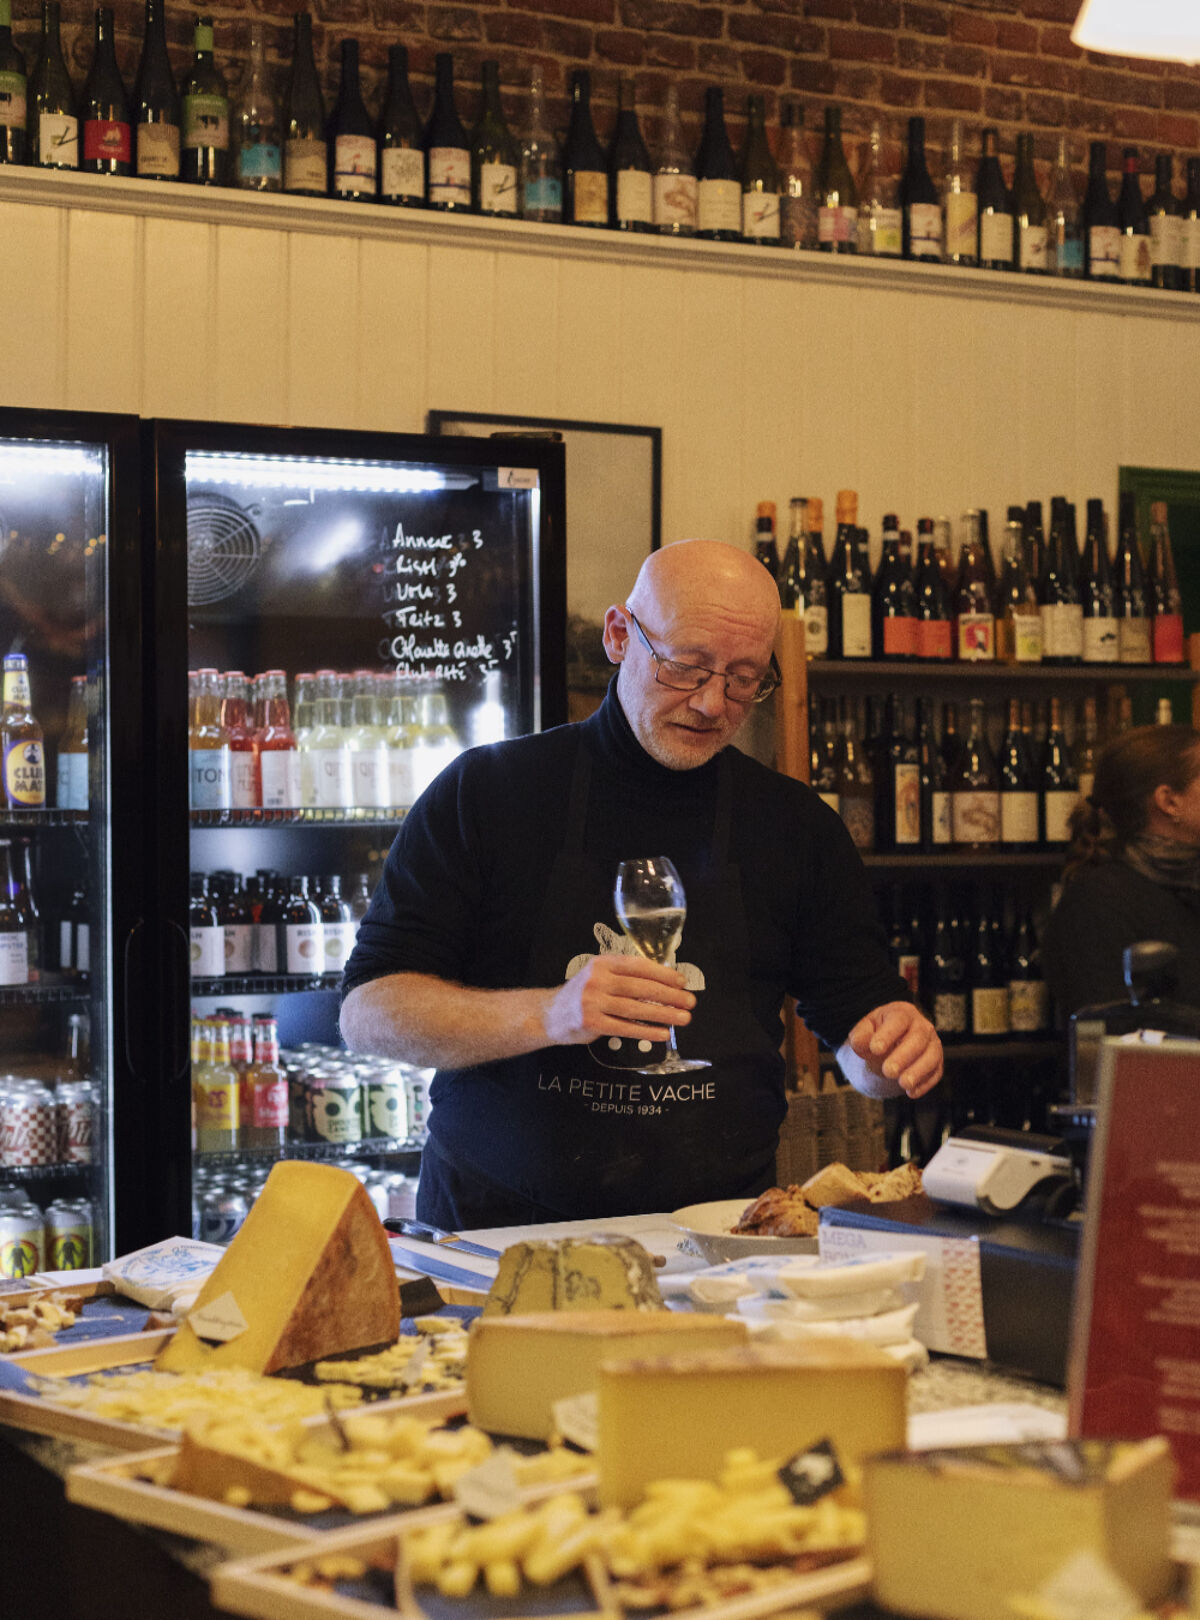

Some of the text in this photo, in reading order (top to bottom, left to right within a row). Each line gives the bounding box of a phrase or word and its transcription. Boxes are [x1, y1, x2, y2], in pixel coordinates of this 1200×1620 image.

[472, 529, 483, 549] 3
[446, 583, 457, 604] 3
[452, 610, 462, 627] 3
[538, 1073, 716, 1102] LA PETITE VACHE
[591, 1102, 662, 1116] DEPUIS 1934
